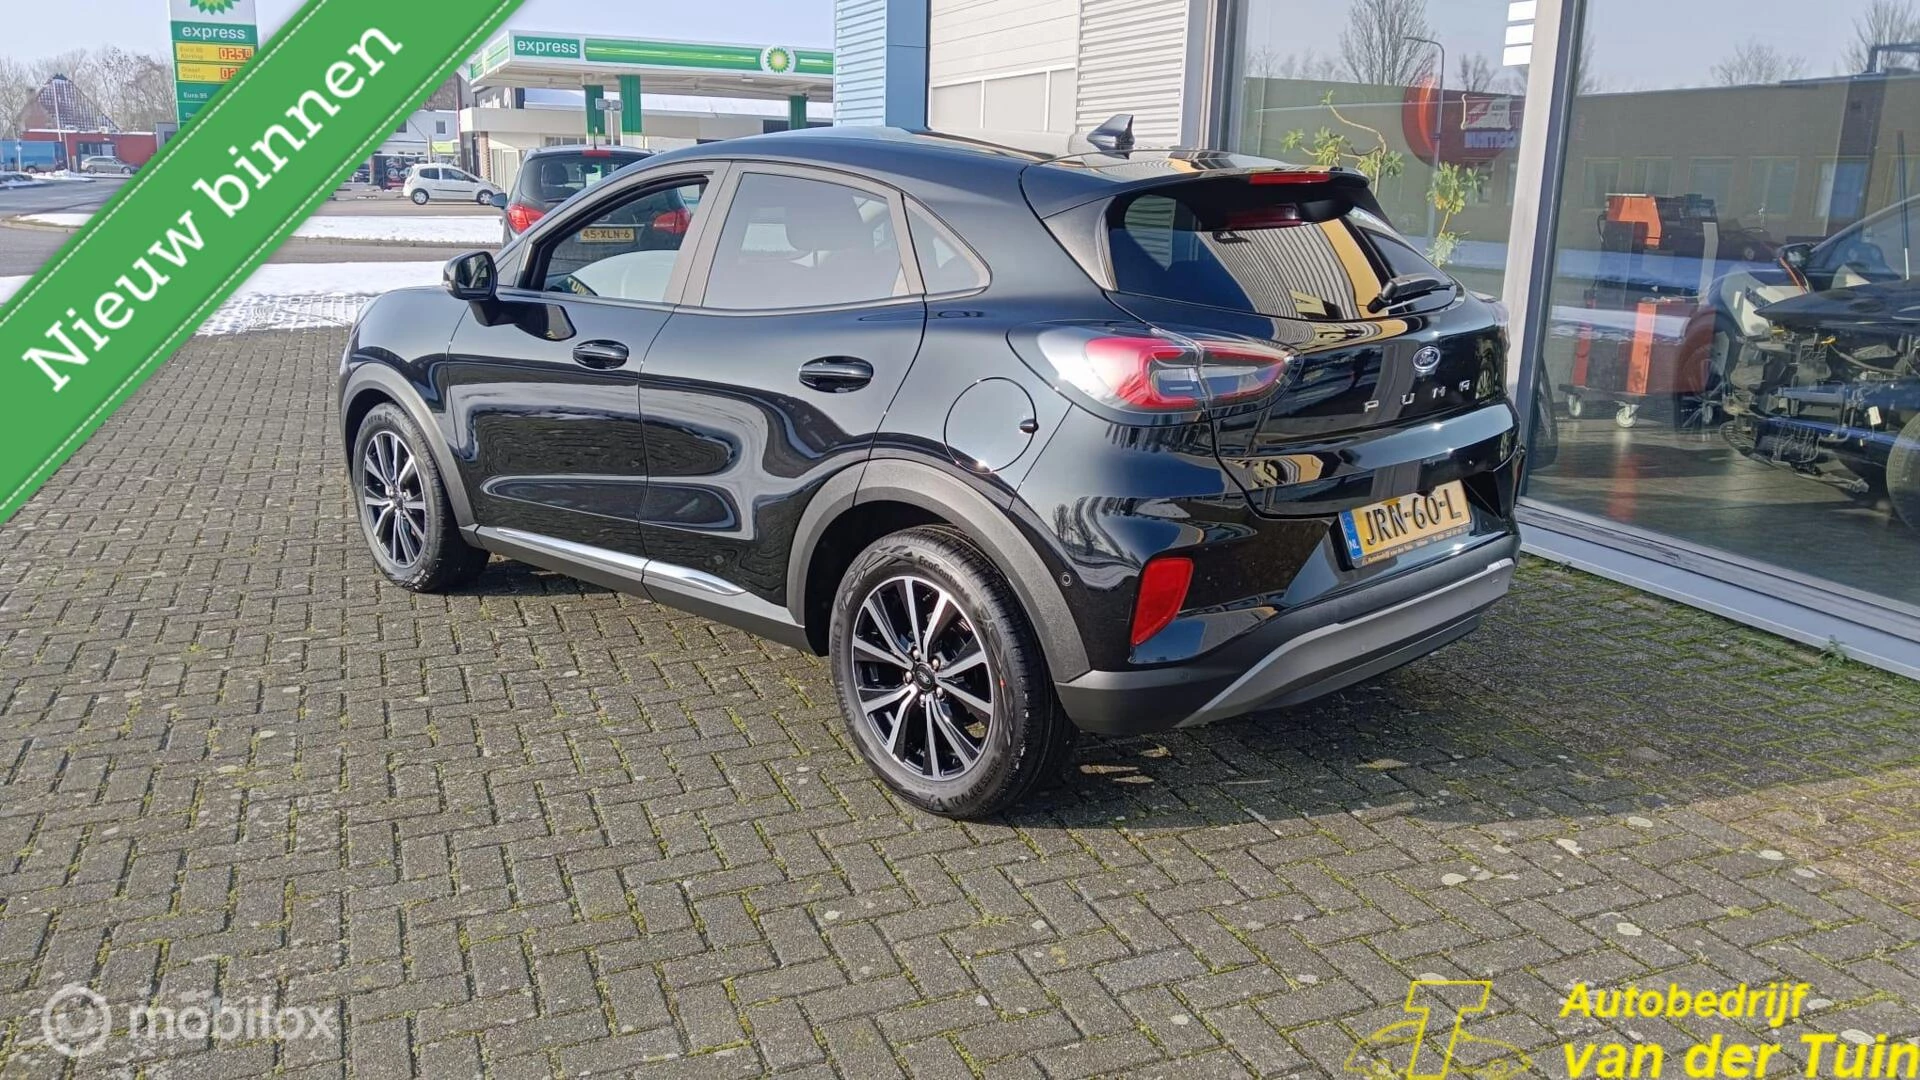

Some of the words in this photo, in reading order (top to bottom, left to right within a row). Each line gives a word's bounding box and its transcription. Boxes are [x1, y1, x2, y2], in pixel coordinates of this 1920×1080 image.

[182, 26, 247, 40] express
[516, 38, 578, 54] express
[582, 227, 631, 239] 45-XLN-6
[1364, 380, 1471, 412] PUMA
[1366, 488, 1462, 546] JRN-60-L
